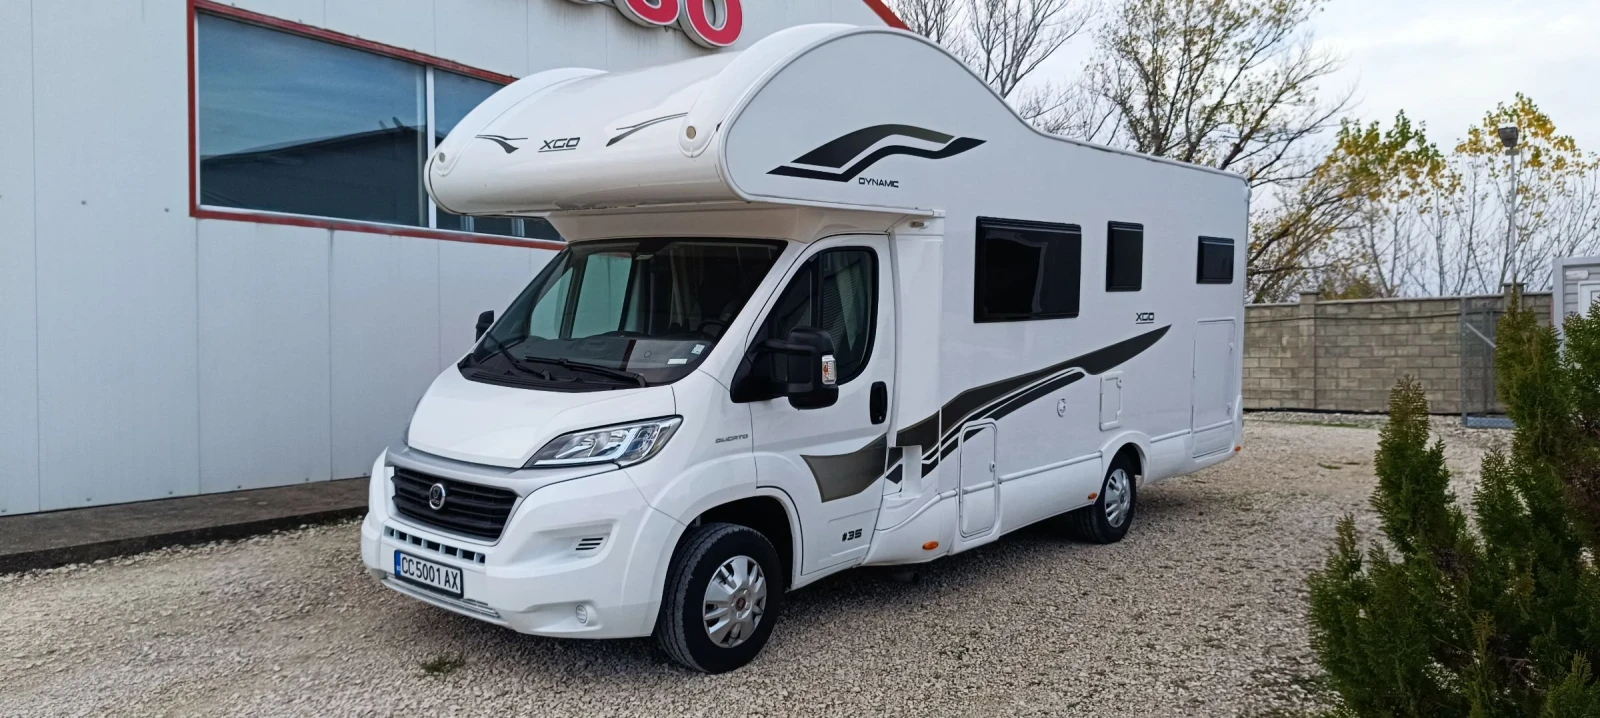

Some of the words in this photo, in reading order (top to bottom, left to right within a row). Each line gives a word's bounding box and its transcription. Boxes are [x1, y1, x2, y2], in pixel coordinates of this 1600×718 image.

[539, 137, 580, 150] XGO
[858, 177, 899, 188] DYNAMIC
[1135, 312, 1155, 322] XGO
[444, 569, 459, 590] AX
